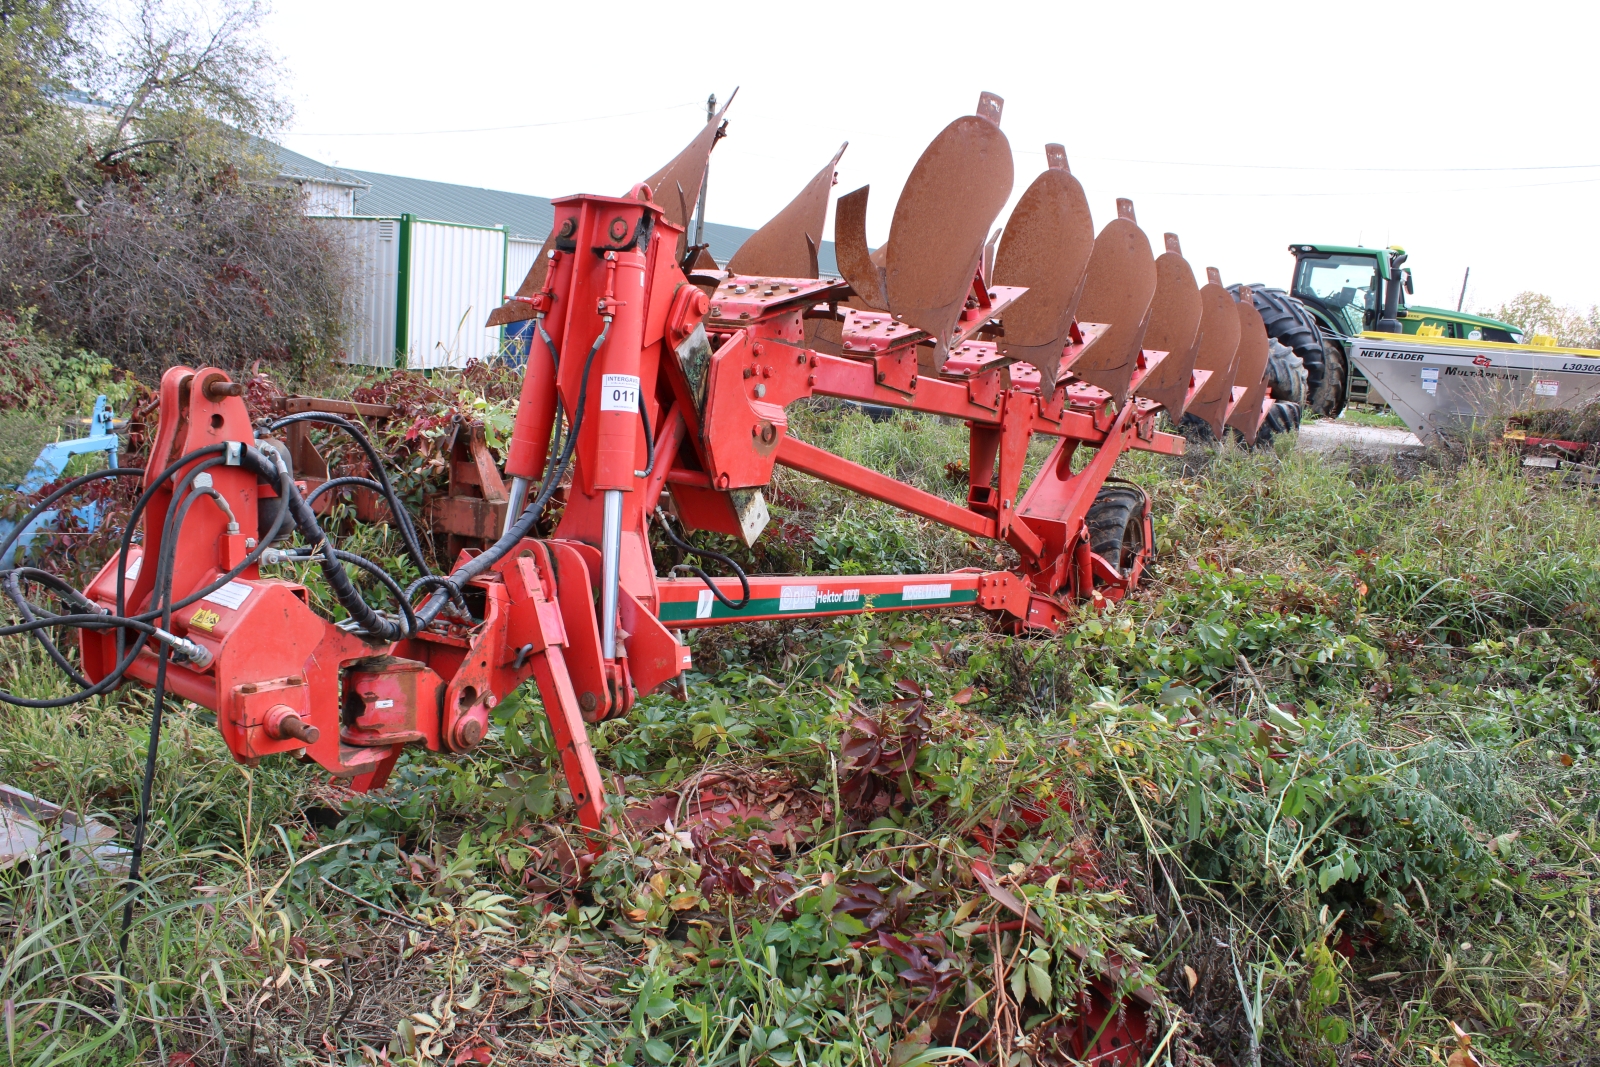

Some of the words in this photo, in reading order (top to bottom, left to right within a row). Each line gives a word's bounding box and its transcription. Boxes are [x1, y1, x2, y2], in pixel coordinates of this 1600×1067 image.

[1360, 350, 1383, 358] NEW
[1385, 352, 1424, 361] LEADER
[613, 389, 635, 403] 011
[816, 589, 842, 603] Hektor
